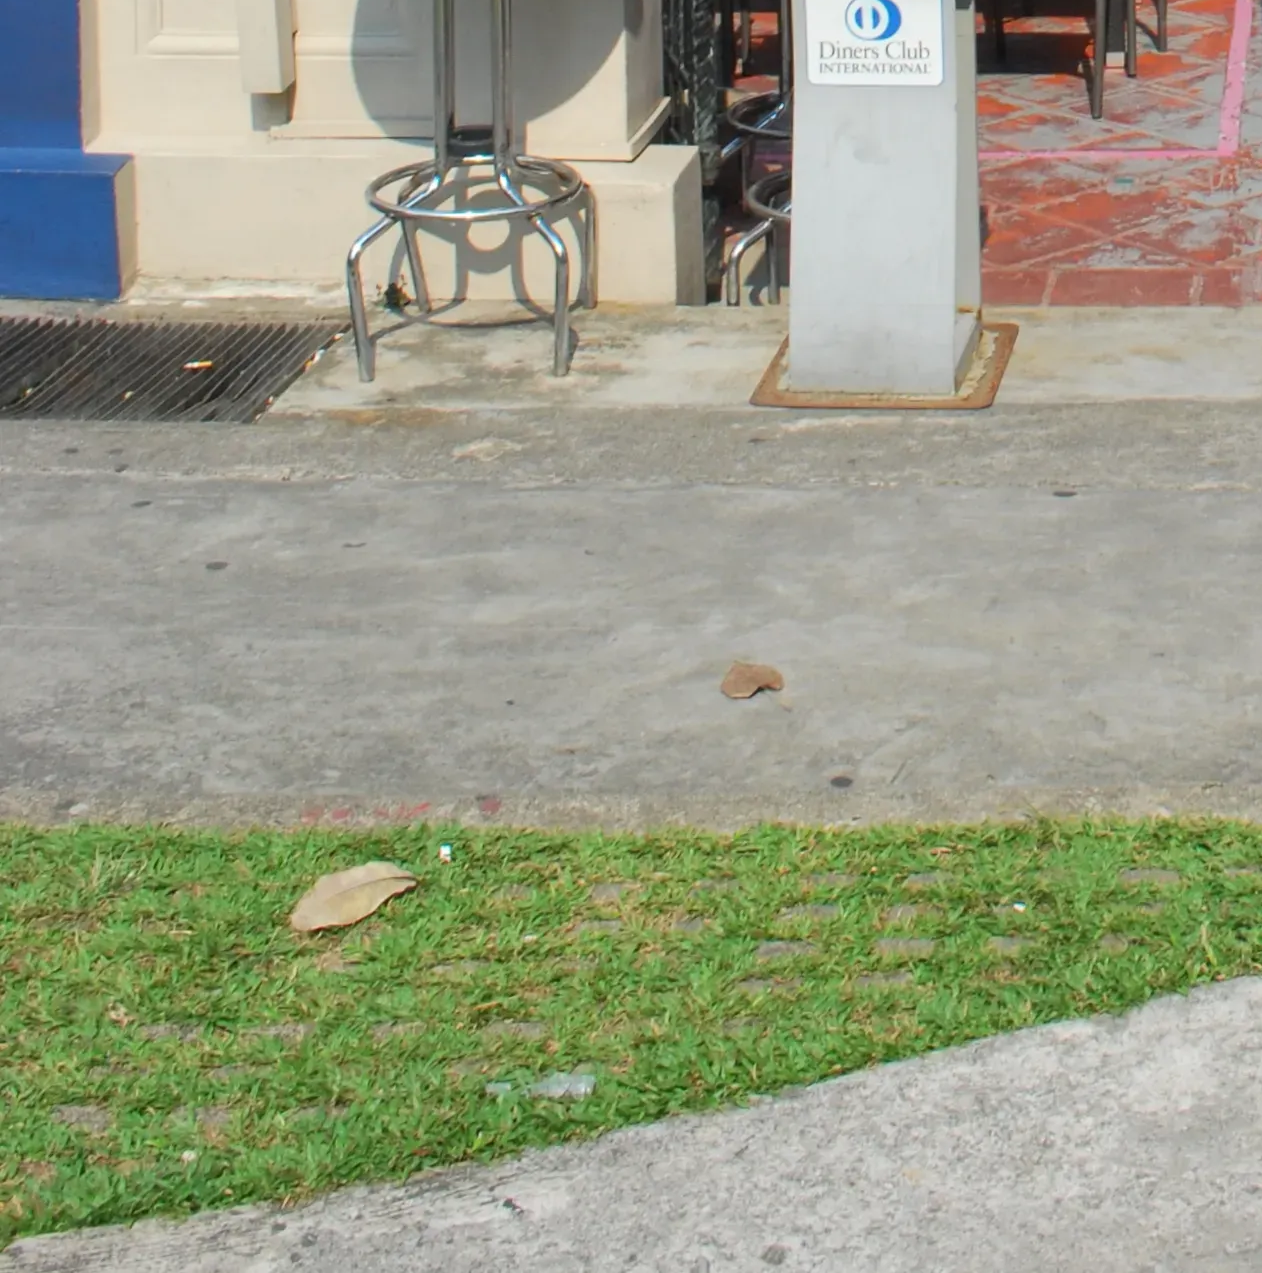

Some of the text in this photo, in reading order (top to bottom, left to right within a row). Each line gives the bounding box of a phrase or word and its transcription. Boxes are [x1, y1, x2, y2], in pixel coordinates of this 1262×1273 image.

[819, 40, 931, 60] Diners Club
[819, 63, 931, 74] INTERNATIONAL
